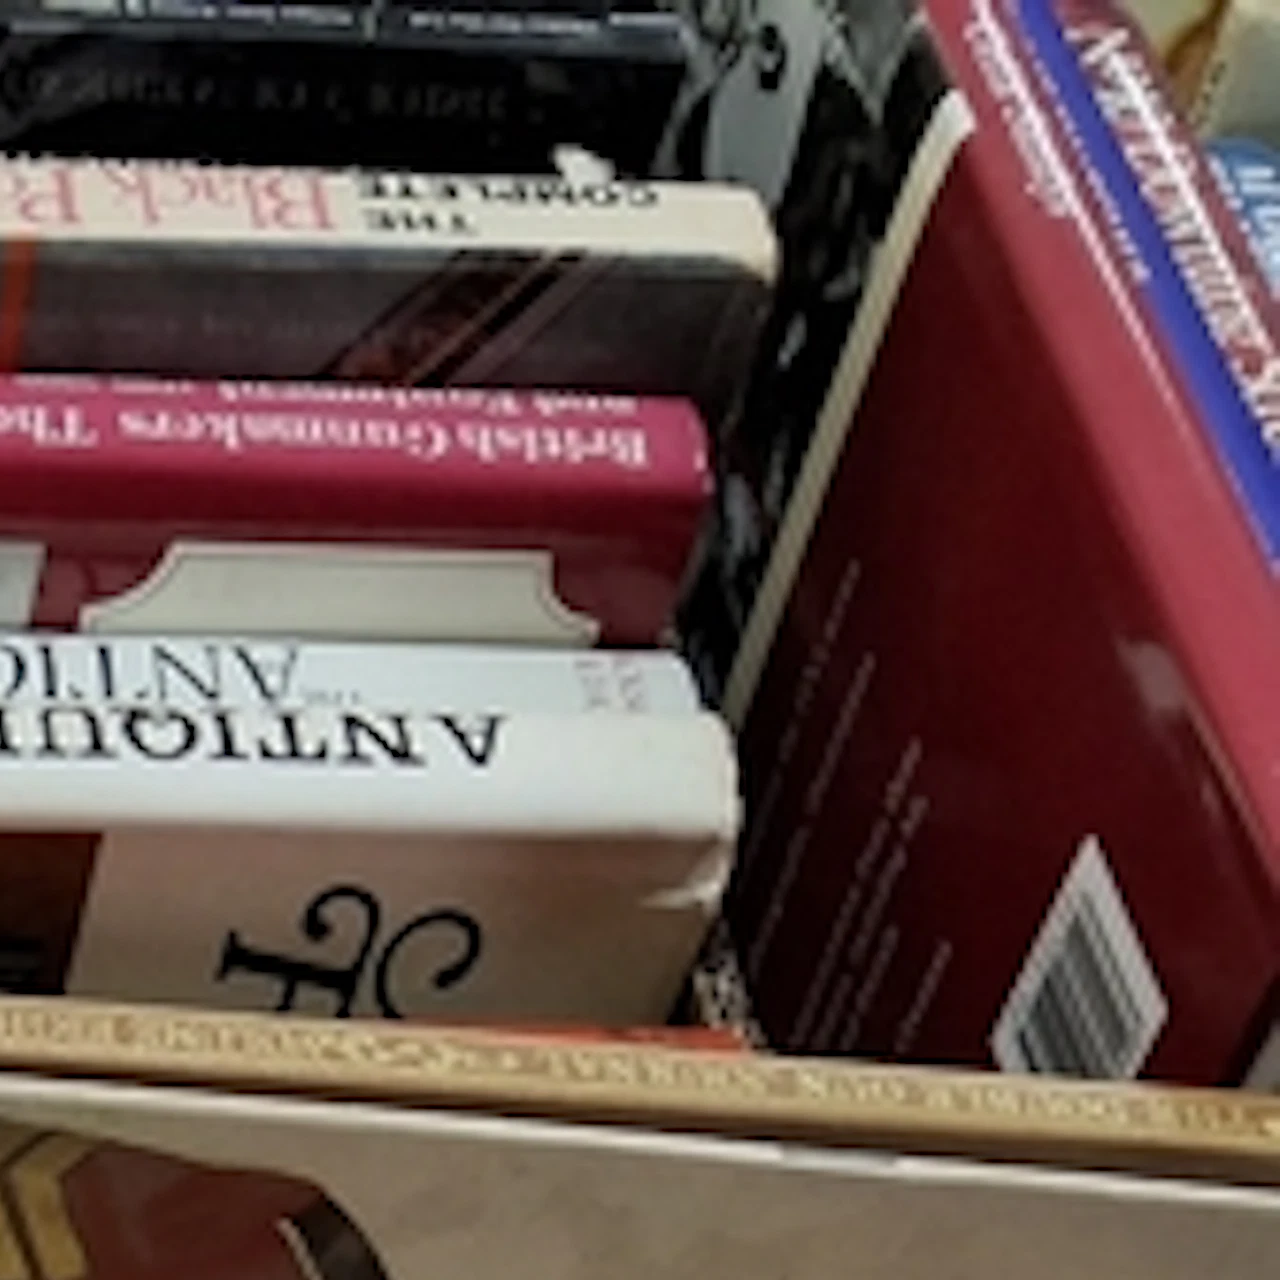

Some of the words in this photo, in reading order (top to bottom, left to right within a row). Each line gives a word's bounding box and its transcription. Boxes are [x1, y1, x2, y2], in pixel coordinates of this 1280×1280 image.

[157, 165, 336, 231] Black
[118, 411, 452, 461] Gunmakers
[457, 424, 648, 468] British
